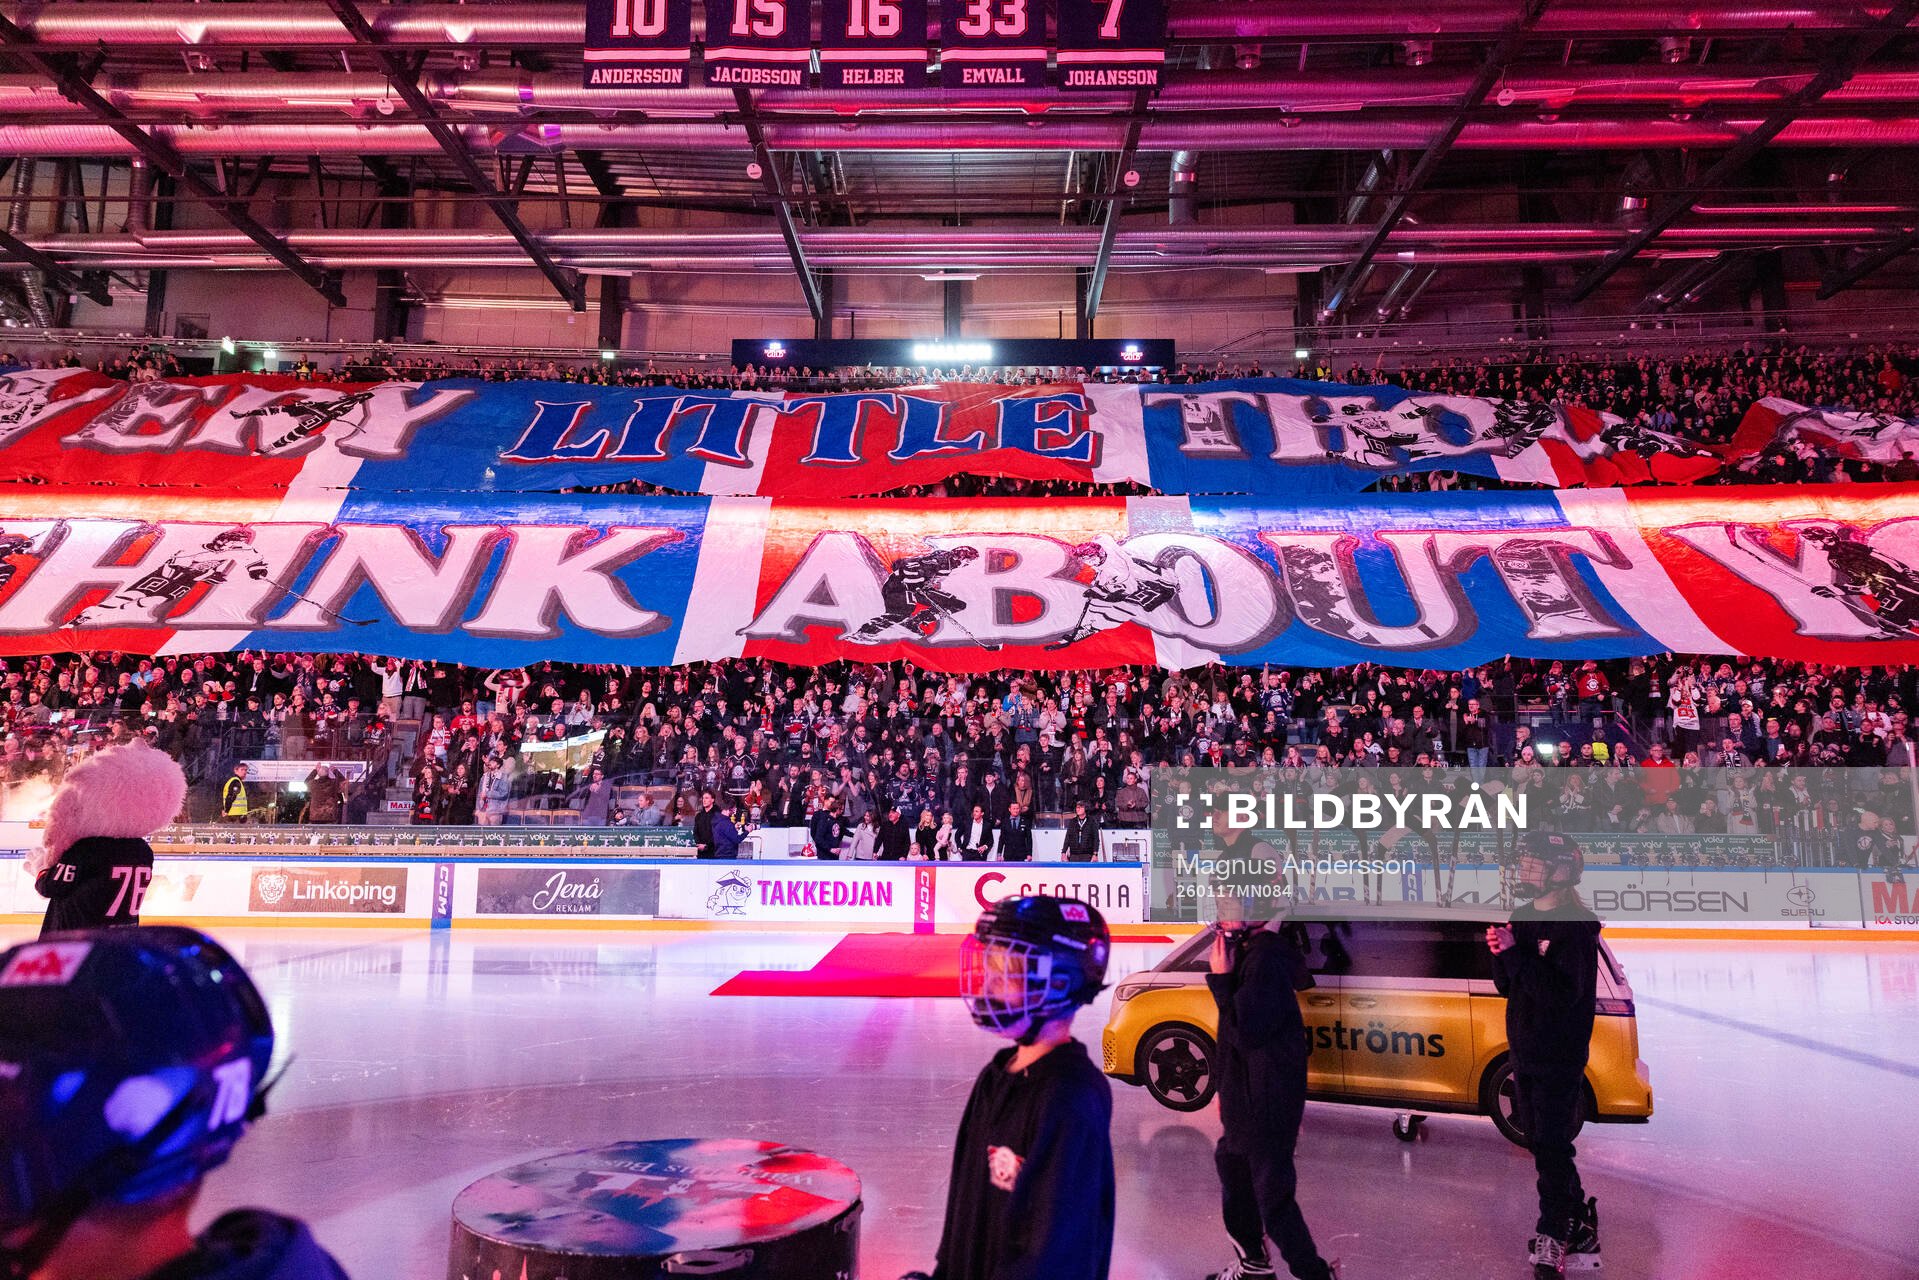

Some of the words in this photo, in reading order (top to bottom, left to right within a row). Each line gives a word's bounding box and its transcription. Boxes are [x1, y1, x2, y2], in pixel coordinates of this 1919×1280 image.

[610, 0, 667, 38] 10
[730, 0, 788, 38] 15
[846, 0, 903, 38] 16
[957, 0, 1028, 38] 33
[590, 68, 683, 84] ANDERSSON
[710, 67, 802, 85] JACOBSSON
[842, 68, 905, 84] HELBER
[962, 68, 1025, 84] EMVALL
[1064, 69, 1158, 86] JOHANSSON
[500, 392, 1102, 467] LITTLE
[0, 518, 685, 635] HINK
[735, 528, 1633, 655] ABOUT
[53, 863, 76, 883] 76
[105, 866, 151, 917] 76
[293, 879, 396, 905] Linköping
[437, 865, 450, 915] CCM
[532, 871, 604, 911] Jenå
[556, 904, 592, 913] REKLAM
[757, 880, 893, 907] TAKKEDJAN
[919, 870, 931, 921] CCM
